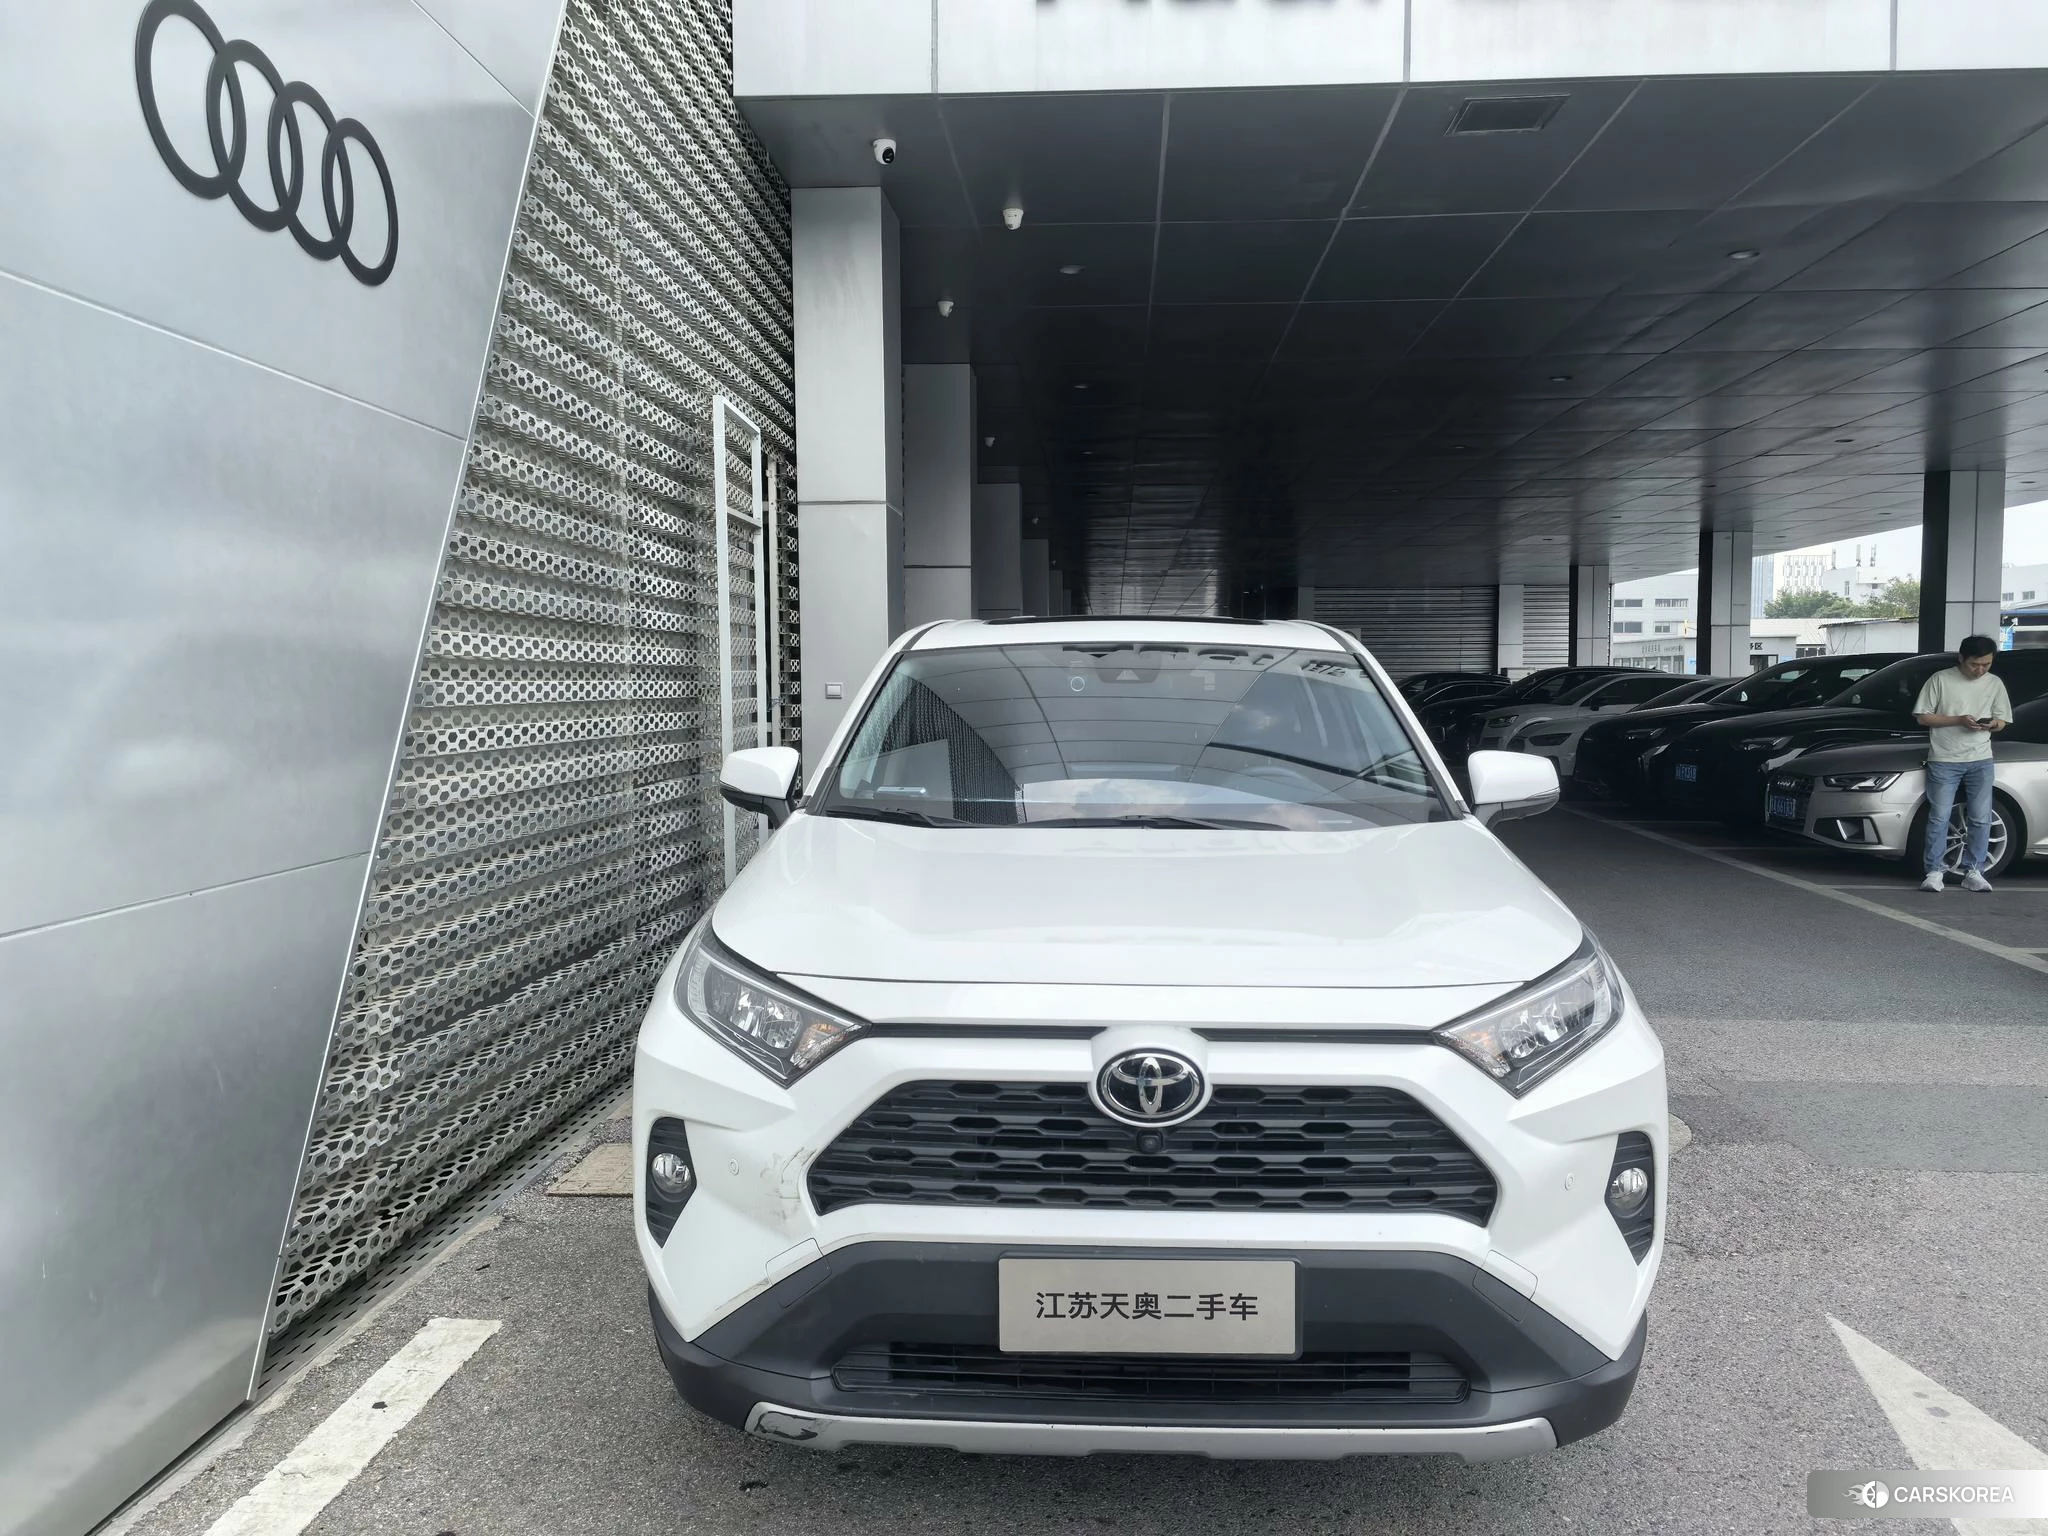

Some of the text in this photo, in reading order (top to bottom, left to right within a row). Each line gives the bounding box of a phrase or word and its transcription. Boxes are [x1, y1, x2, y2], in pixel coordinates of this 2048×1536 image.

[1036, 1292, 1258, 1321] 江苏天奥二手车
